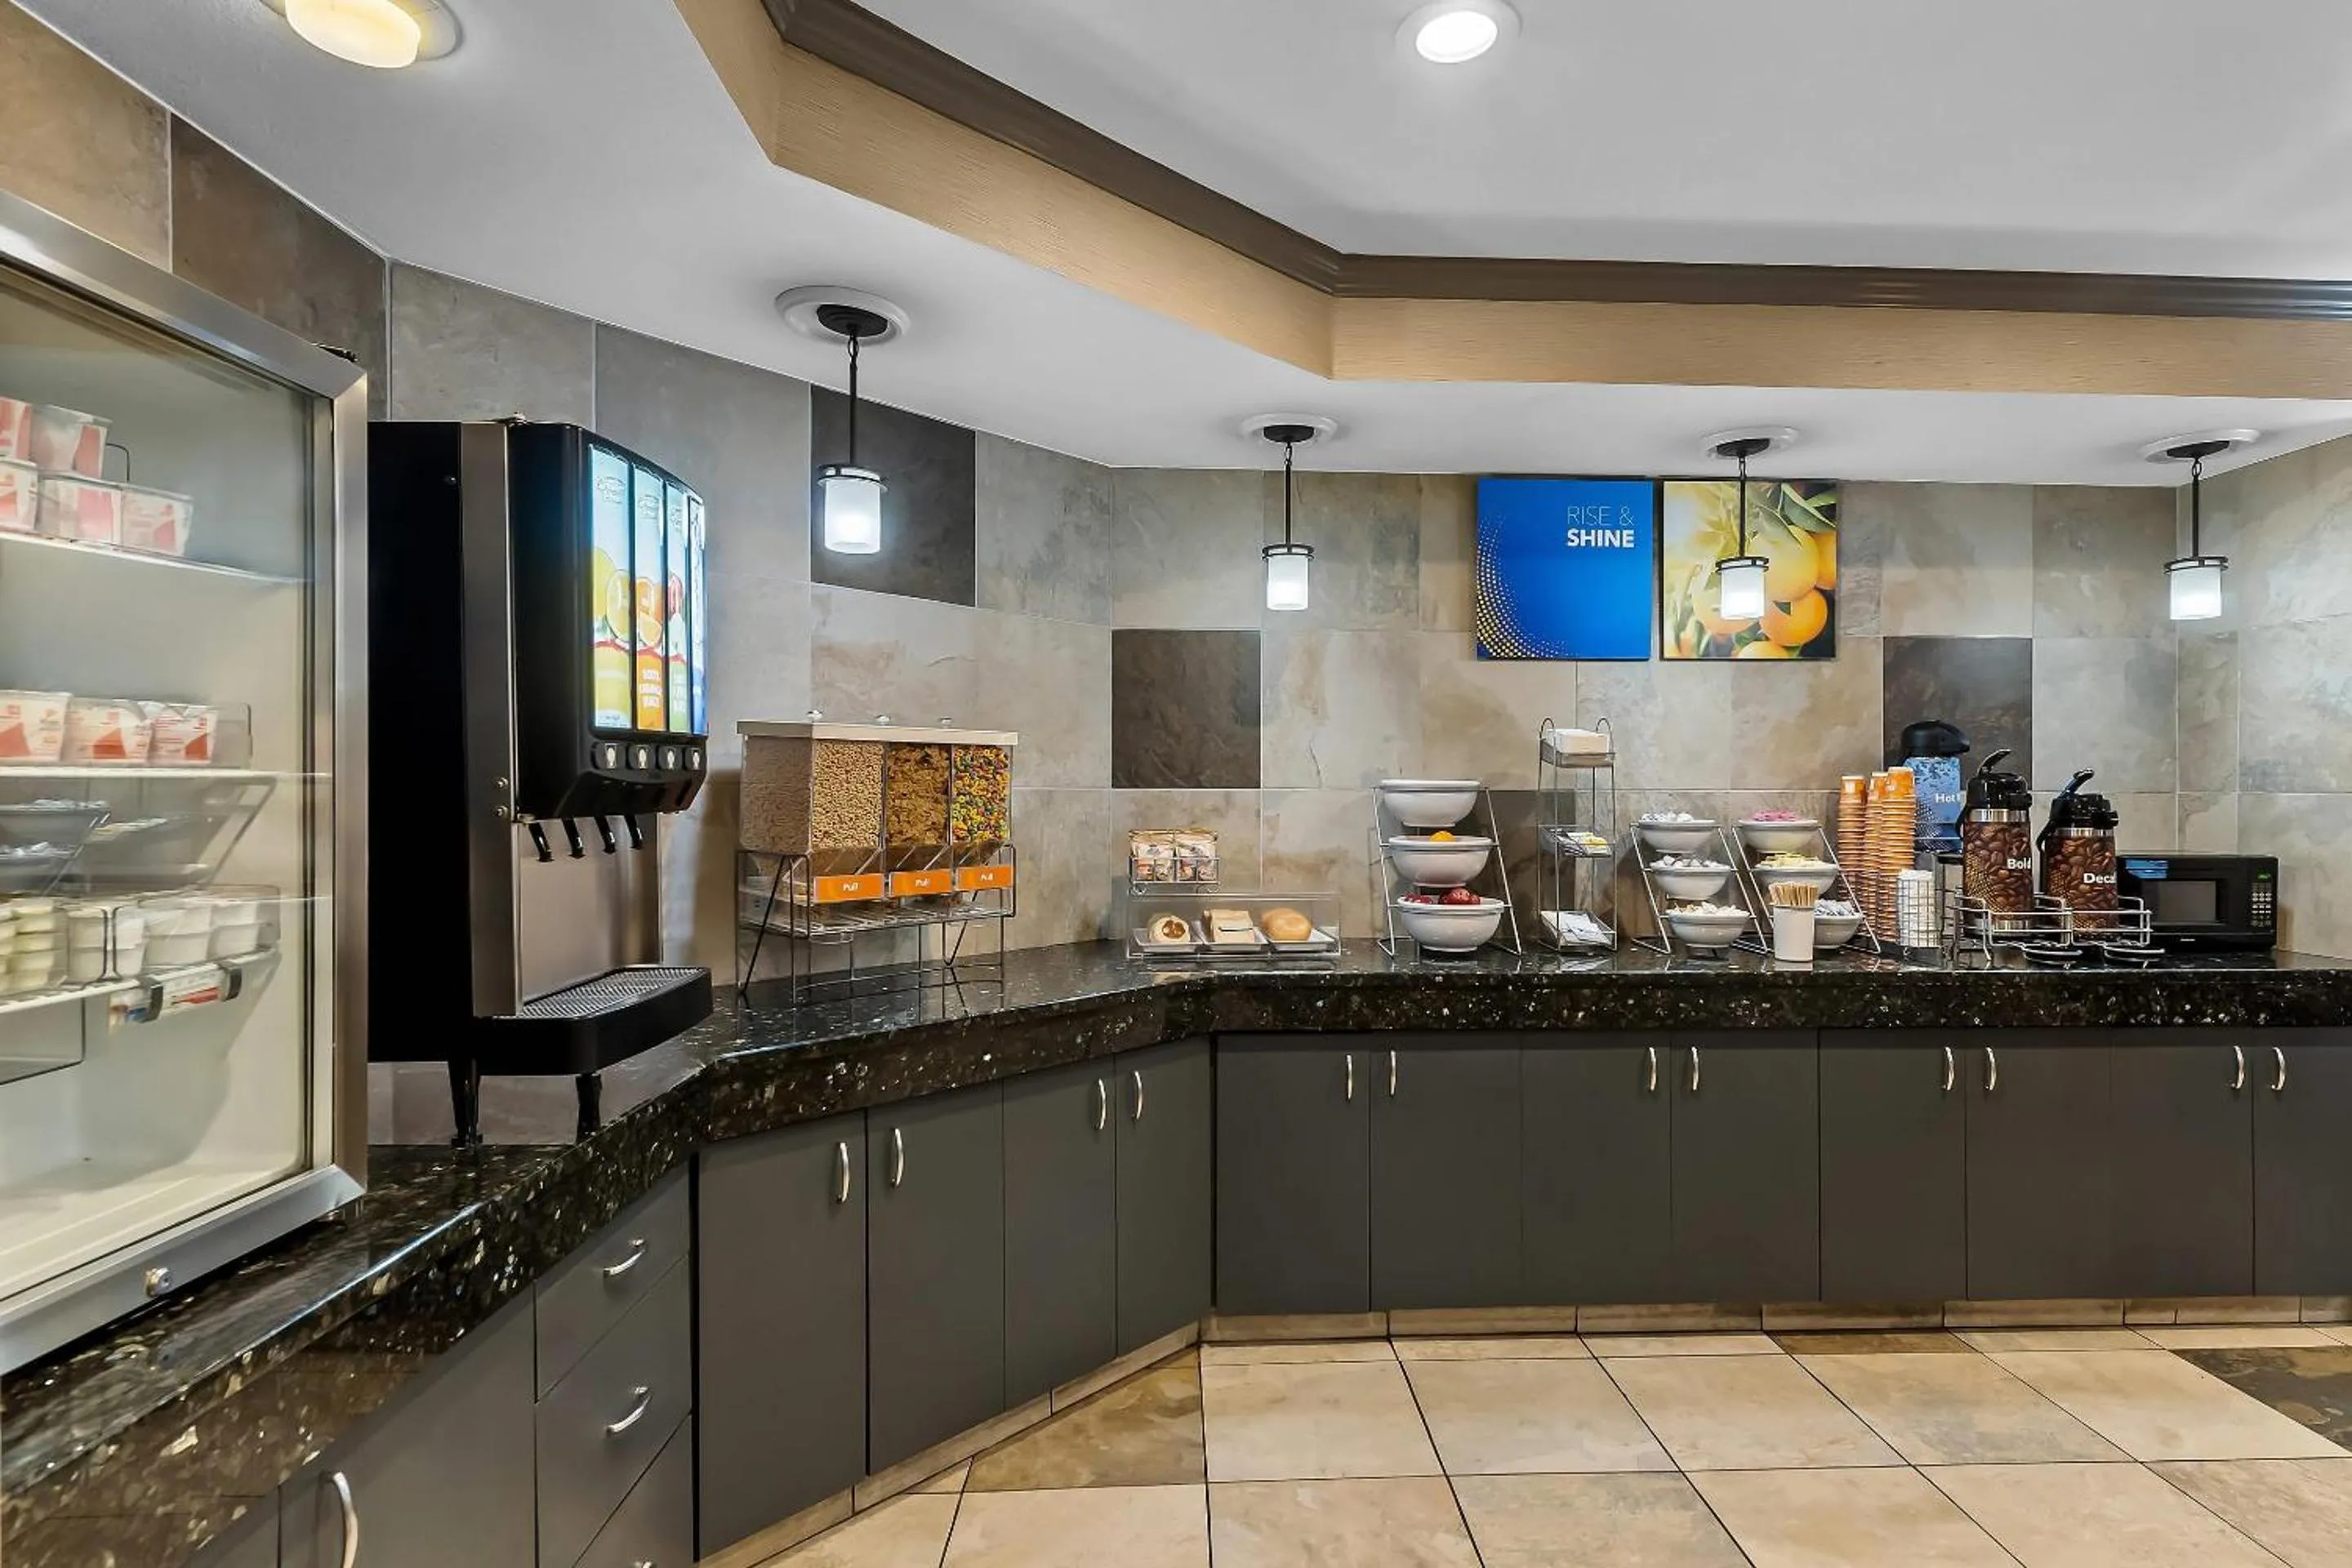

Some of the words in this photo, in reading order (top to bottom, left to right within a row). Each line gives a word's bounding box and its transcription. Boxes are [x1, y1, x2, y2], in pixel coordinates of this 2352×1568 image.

[1567, 506, 1612, 526] RISE
[1619, 506, 1634, 526] &
[1567, 528, 1635, 548] SHINE
[1936, 792, 1956, 804] Hot
[2007, 857, 2032, 870] Bold
